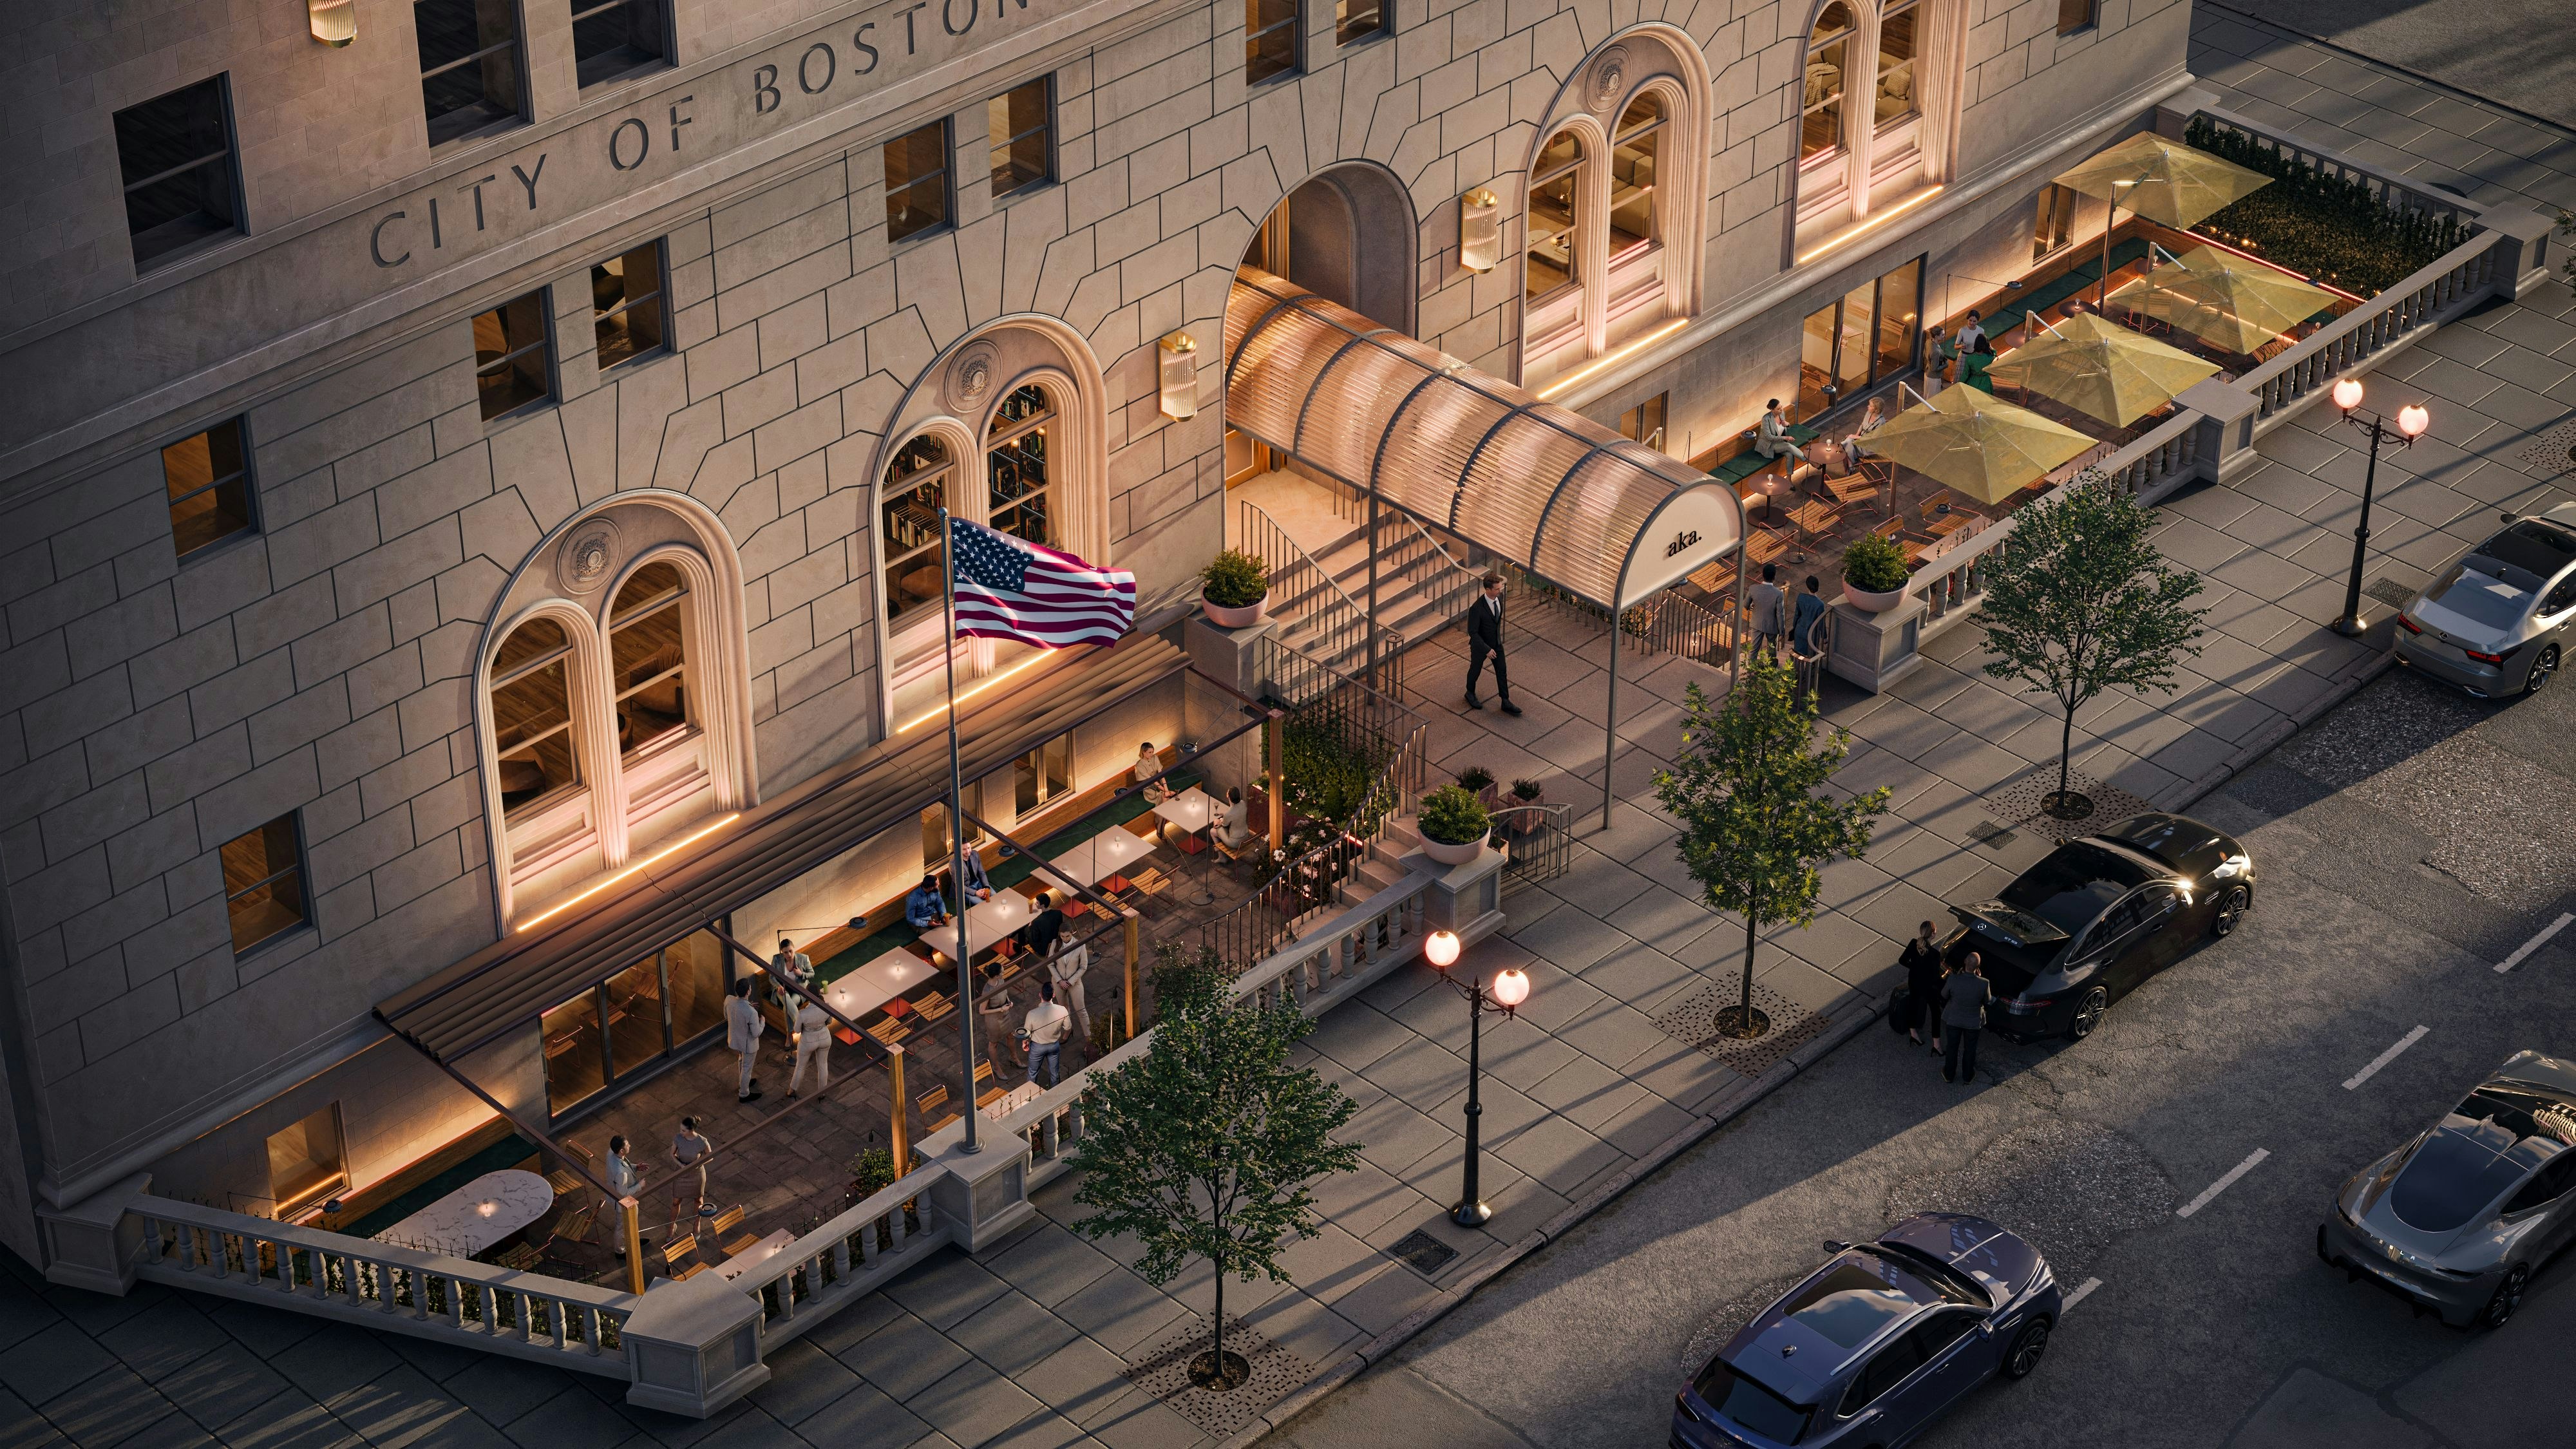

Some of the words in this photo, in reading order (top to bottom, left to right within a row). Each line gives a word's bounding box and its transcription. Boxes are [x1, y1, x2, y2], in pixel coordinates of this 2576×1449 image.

[370, 153, 547, 269] CITY
[609, 95, 693, 173] OF
[1668, 531, 1702, 557] aka.
[2370, 1233, 2416, 1260] TESLA
